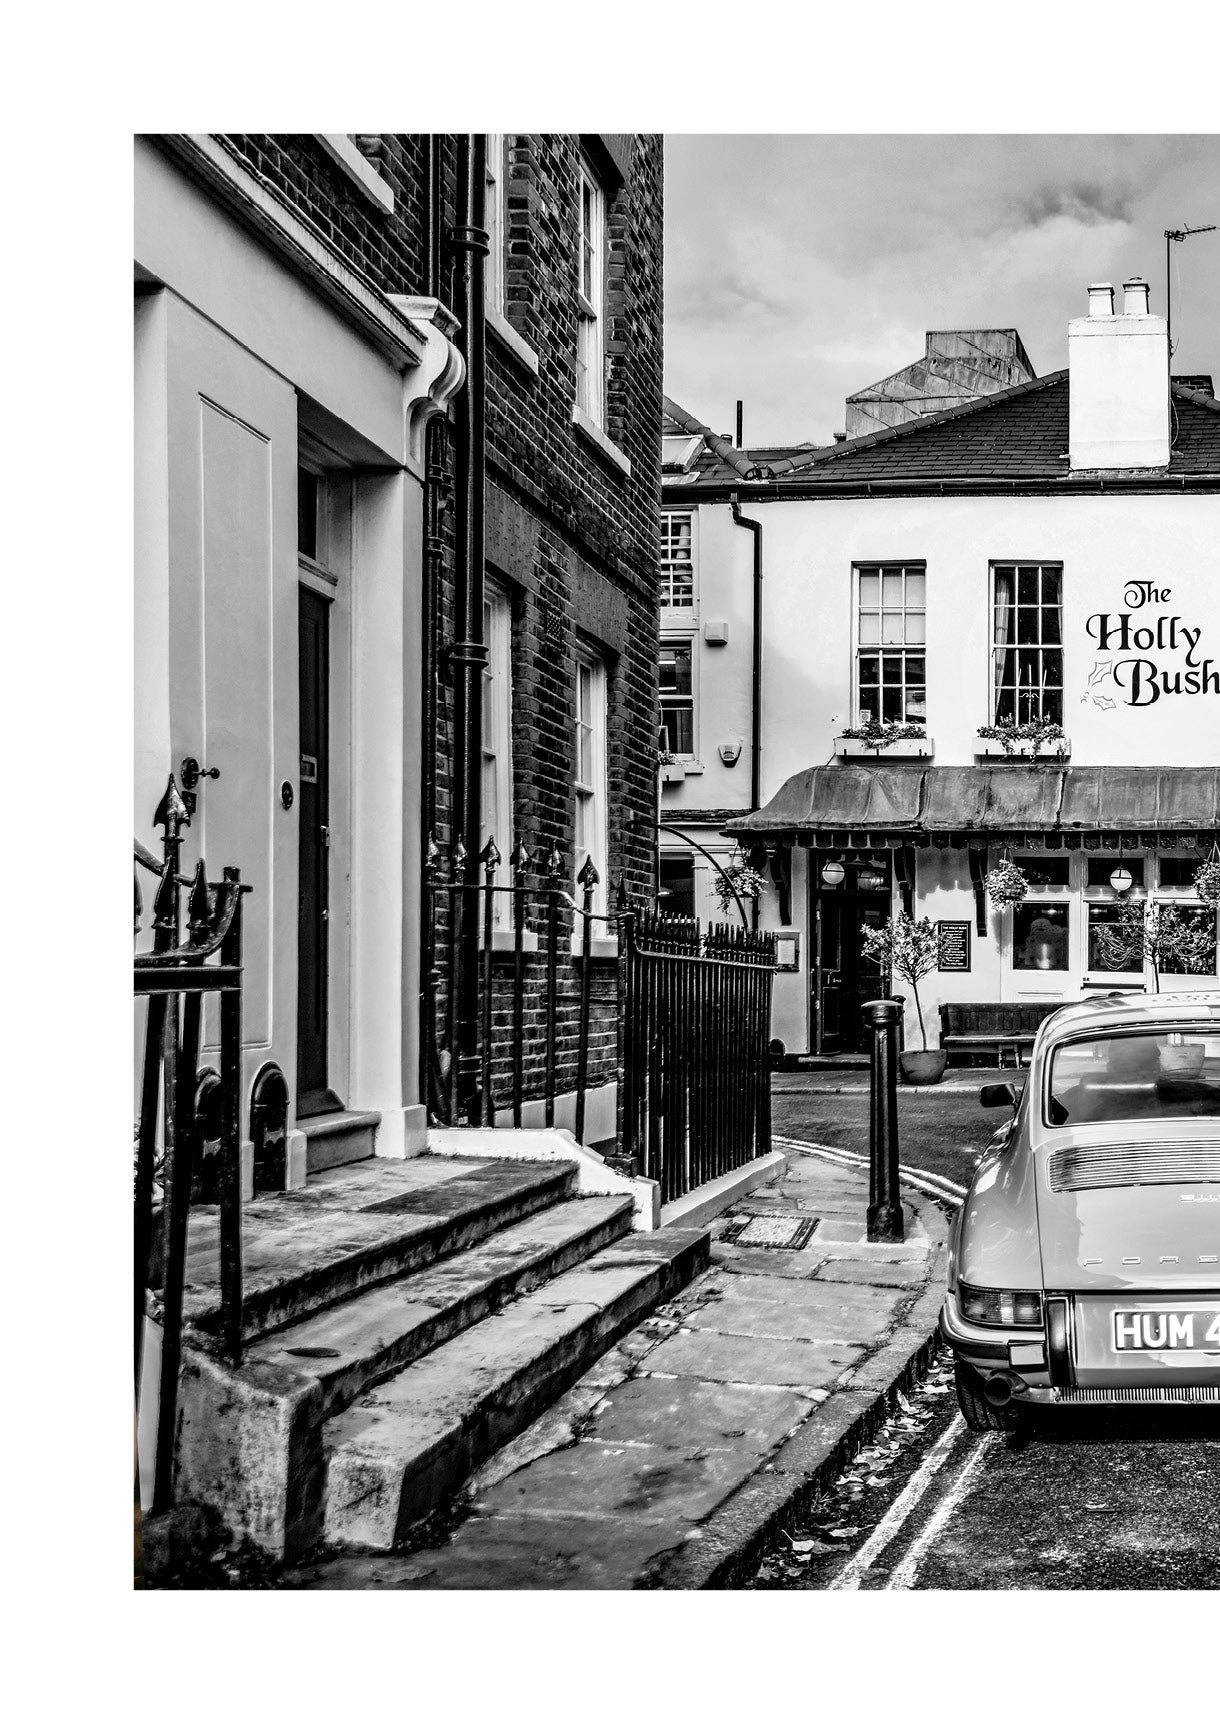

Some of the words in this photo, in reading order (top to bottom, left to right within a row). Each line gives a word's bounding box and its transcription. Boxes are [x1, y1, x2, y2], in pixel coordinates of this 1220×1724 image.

[1124, 580, 1172, 609] The
[1086, 614, 1202, 668] Holly
[1116, 1314, 1194, 1348] HUM
